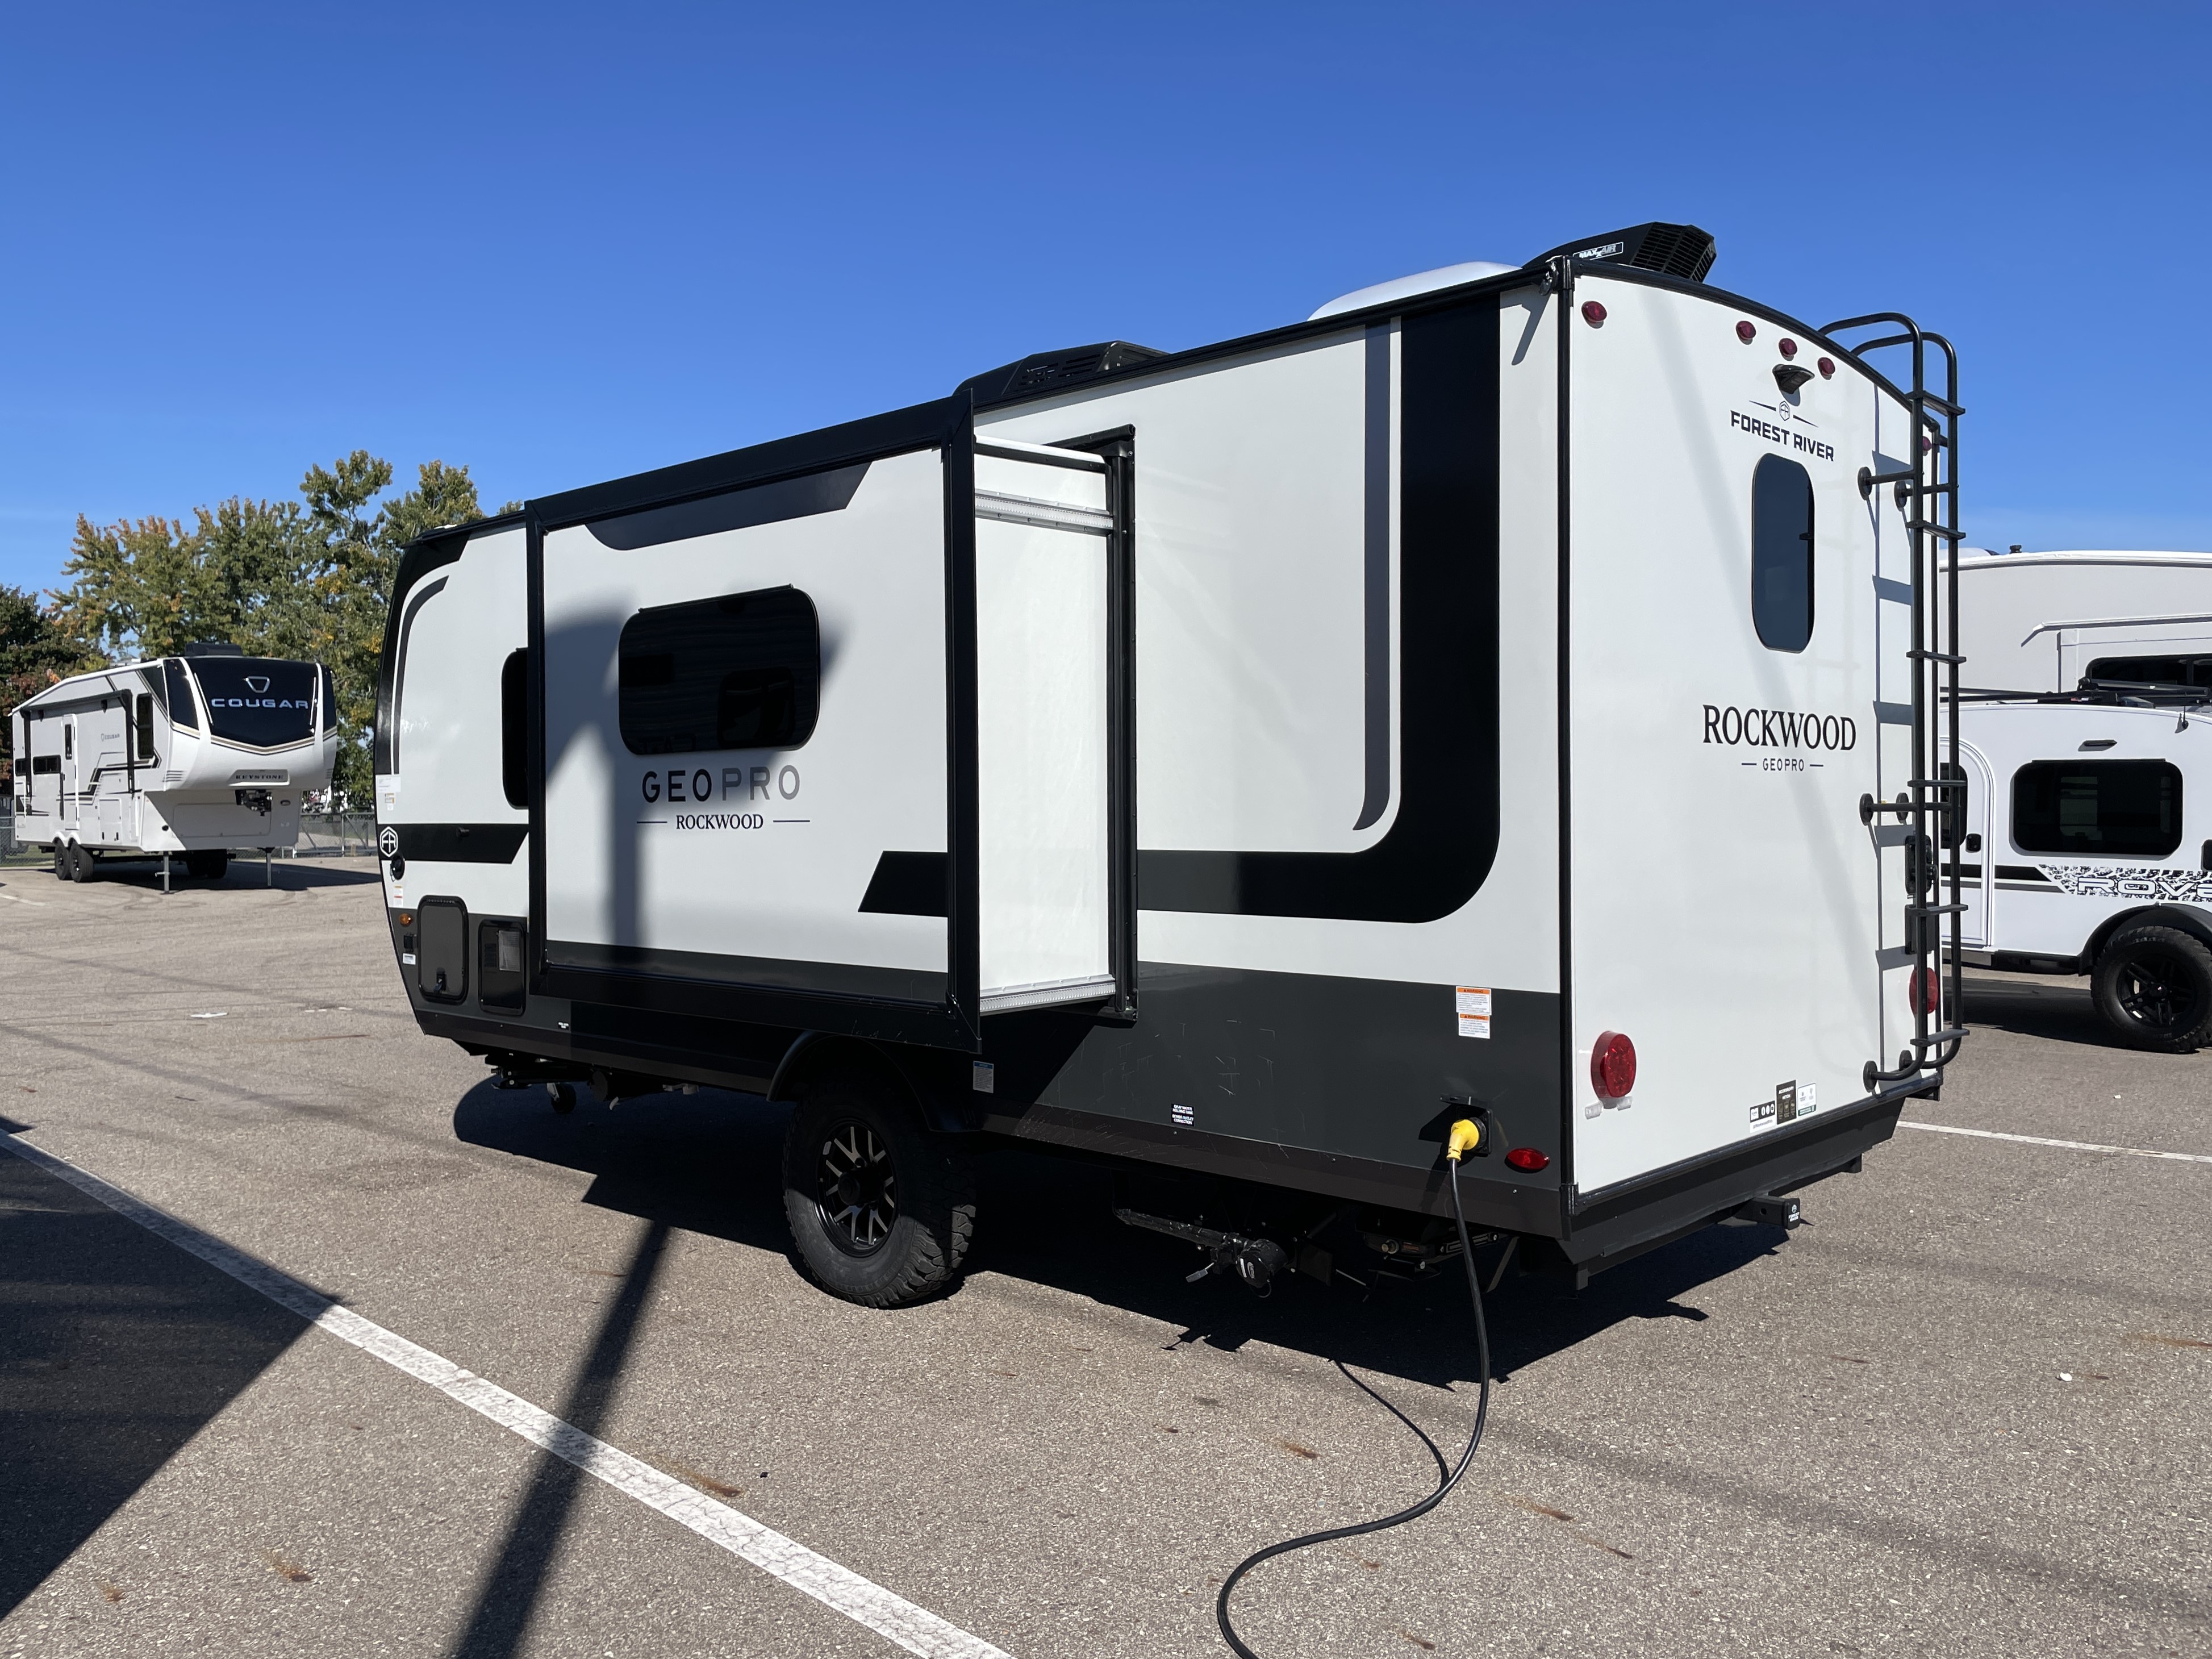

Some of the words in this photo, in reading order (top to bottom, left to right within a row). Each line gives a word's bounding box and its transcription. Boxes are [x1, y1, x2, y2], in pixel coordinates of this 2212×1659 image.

[1730, 410, 1790, 445] FOREST
[1793, 433, 1834, 462] RIVER
[211, 698, 309, 710] COUGAR
[1702, 704, 1857, 751] ROCKWOOD
[1762, 758, 1805, 772] GEOPRO
[641, 764, 801, 803] GEOPRO
[676, 814, 764, 830] ROCKWOOD
